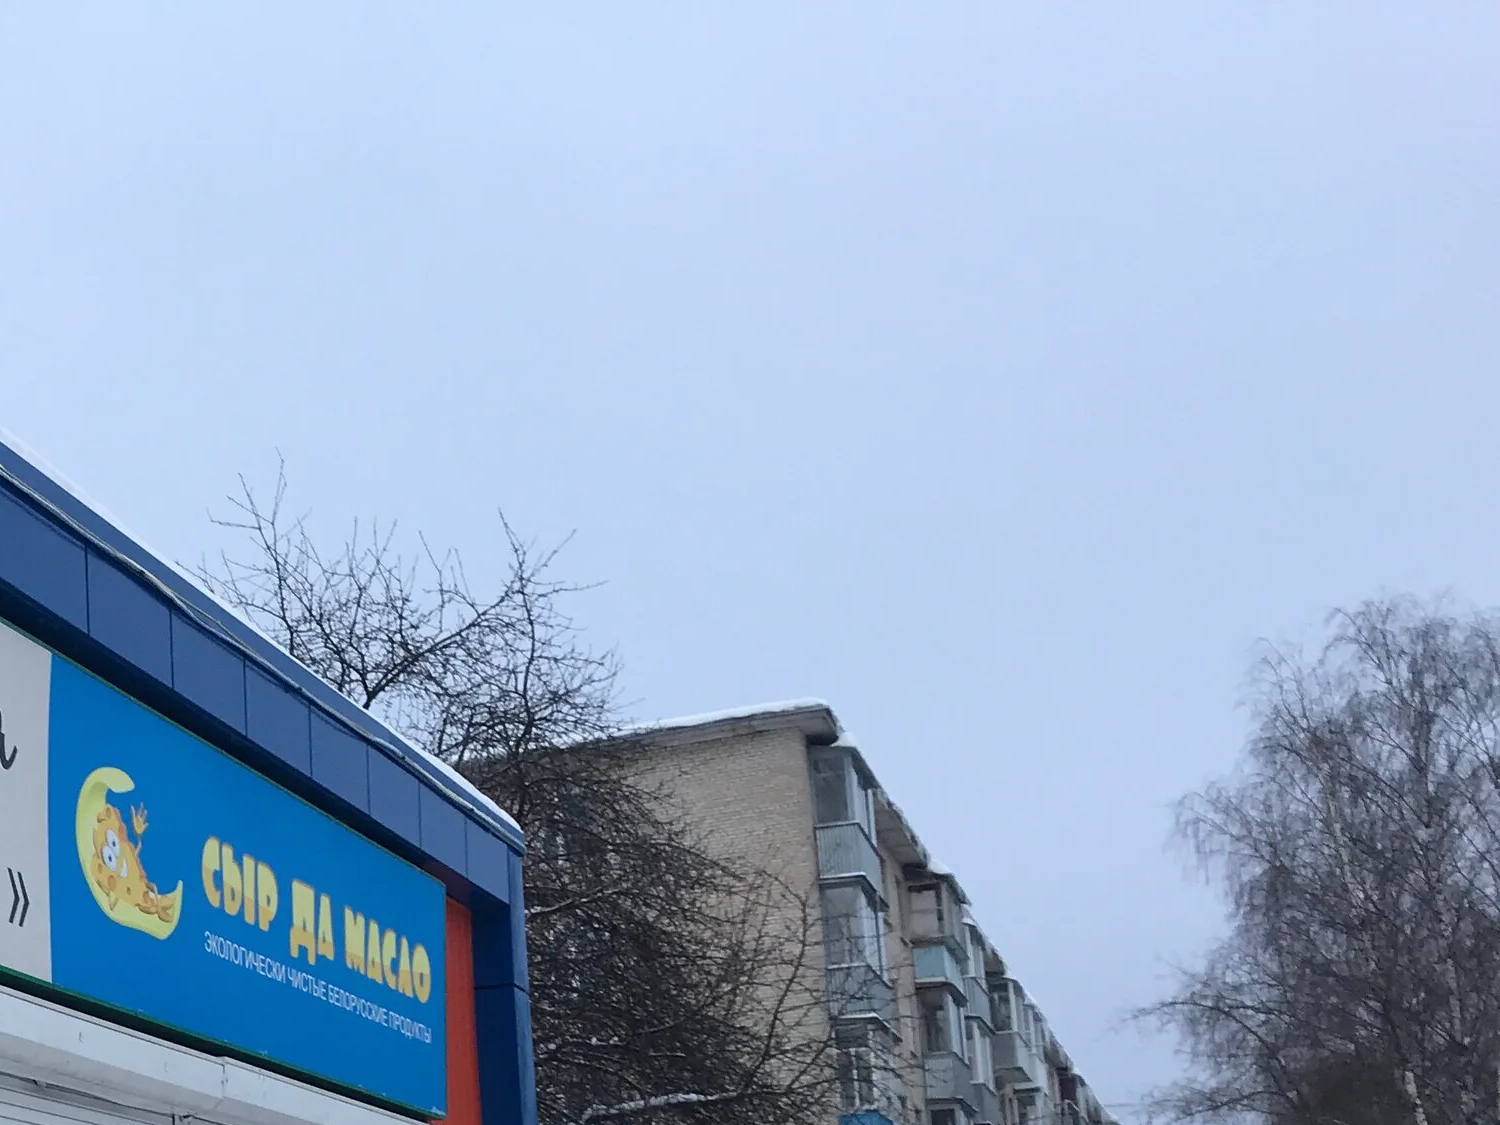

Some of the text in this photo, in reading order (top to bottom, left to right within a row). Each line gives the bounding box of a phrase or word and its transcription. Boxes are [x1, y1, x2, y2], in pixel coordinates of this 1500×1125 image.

[201, 835, 432, 1005] СЫР ДА МАСЛО
[204, 930, 432, 1044] ЭКОЛОГИЧЕСКИ ЧИСТЫЕ БЕЛОРУССКИЕ ПРОДУКТЫ
